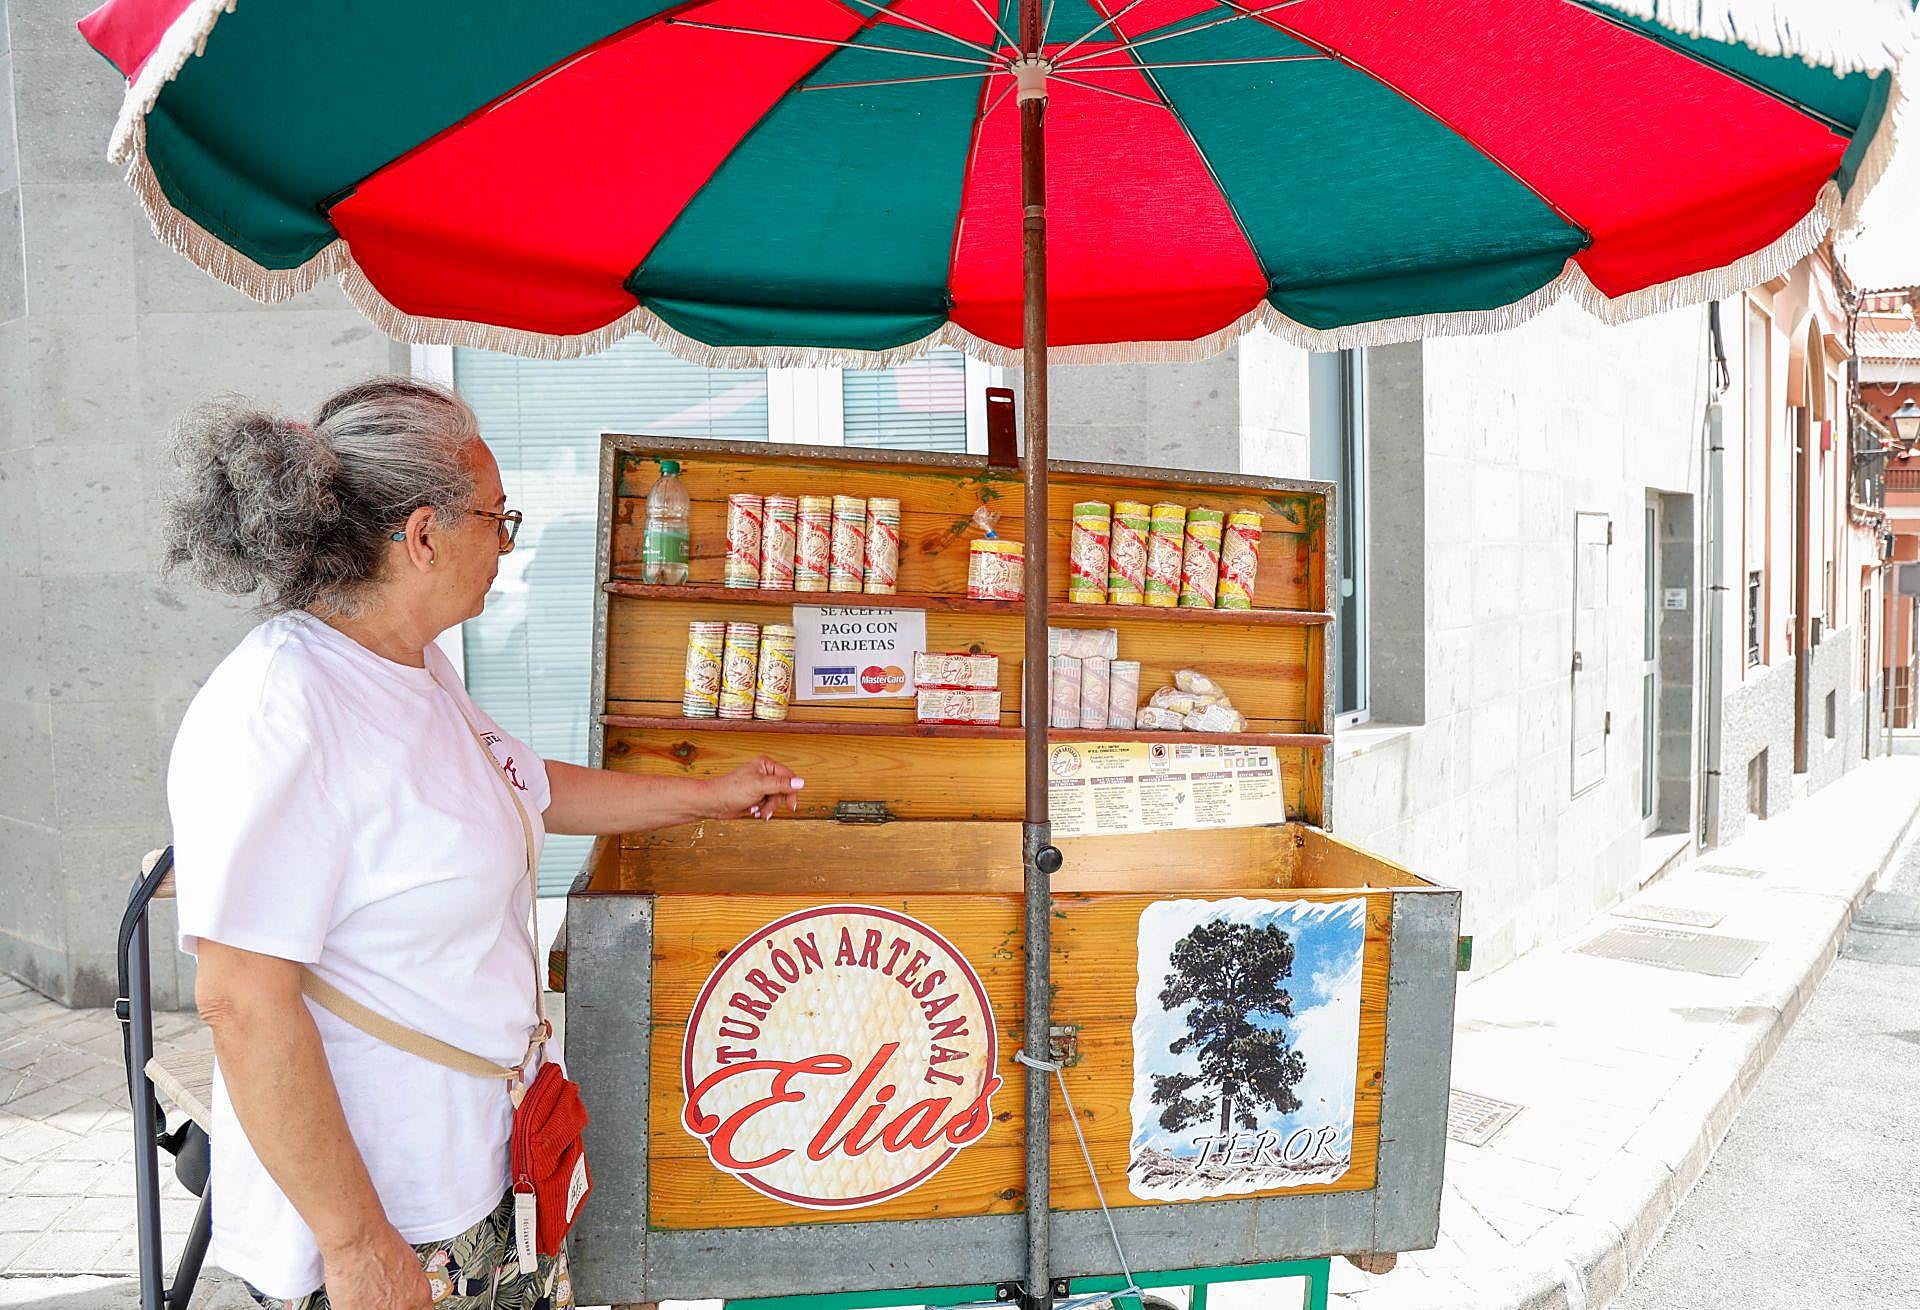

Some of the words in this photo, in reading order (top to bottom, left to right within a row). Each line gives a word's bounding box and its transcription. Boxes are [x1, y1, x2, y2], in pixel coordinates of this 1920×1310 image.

[821, 622, 861, 635] PAGO
[866, 622, 898, 634] CON
[820, 638, 895, 652] TARJETAS
[821, 675, 849, 686] VISA
[861, 675, 905, 685] MasterCard
[716, 931, 825, 1065] TURRÓN
[834, 926, 970, 1086] ARTESANAL
[685, 1041, 1002, 1171] Elias
[1192, 1124, 1344, 1172] TEROR
